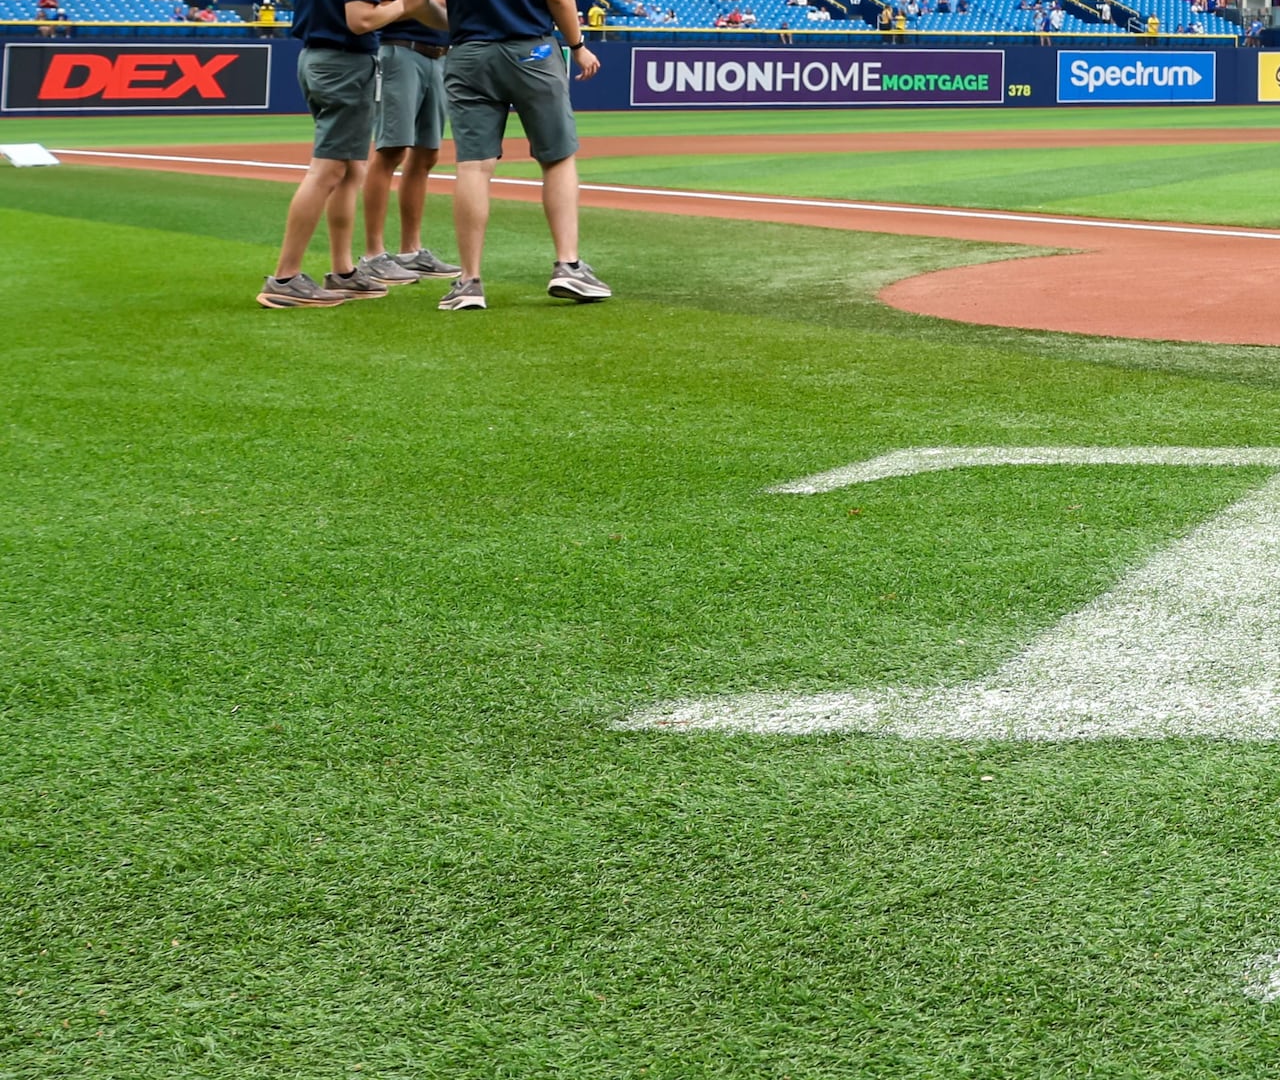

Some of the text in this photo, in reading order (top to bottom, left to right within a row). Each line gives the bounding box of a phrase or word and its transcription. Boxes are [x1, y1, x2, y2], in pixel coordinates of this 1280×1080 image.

[38, 54, 239, 99] DEX
[1008, 84, 1031, 97] 378
[1071, 60, 1194, 94] Spectrum
